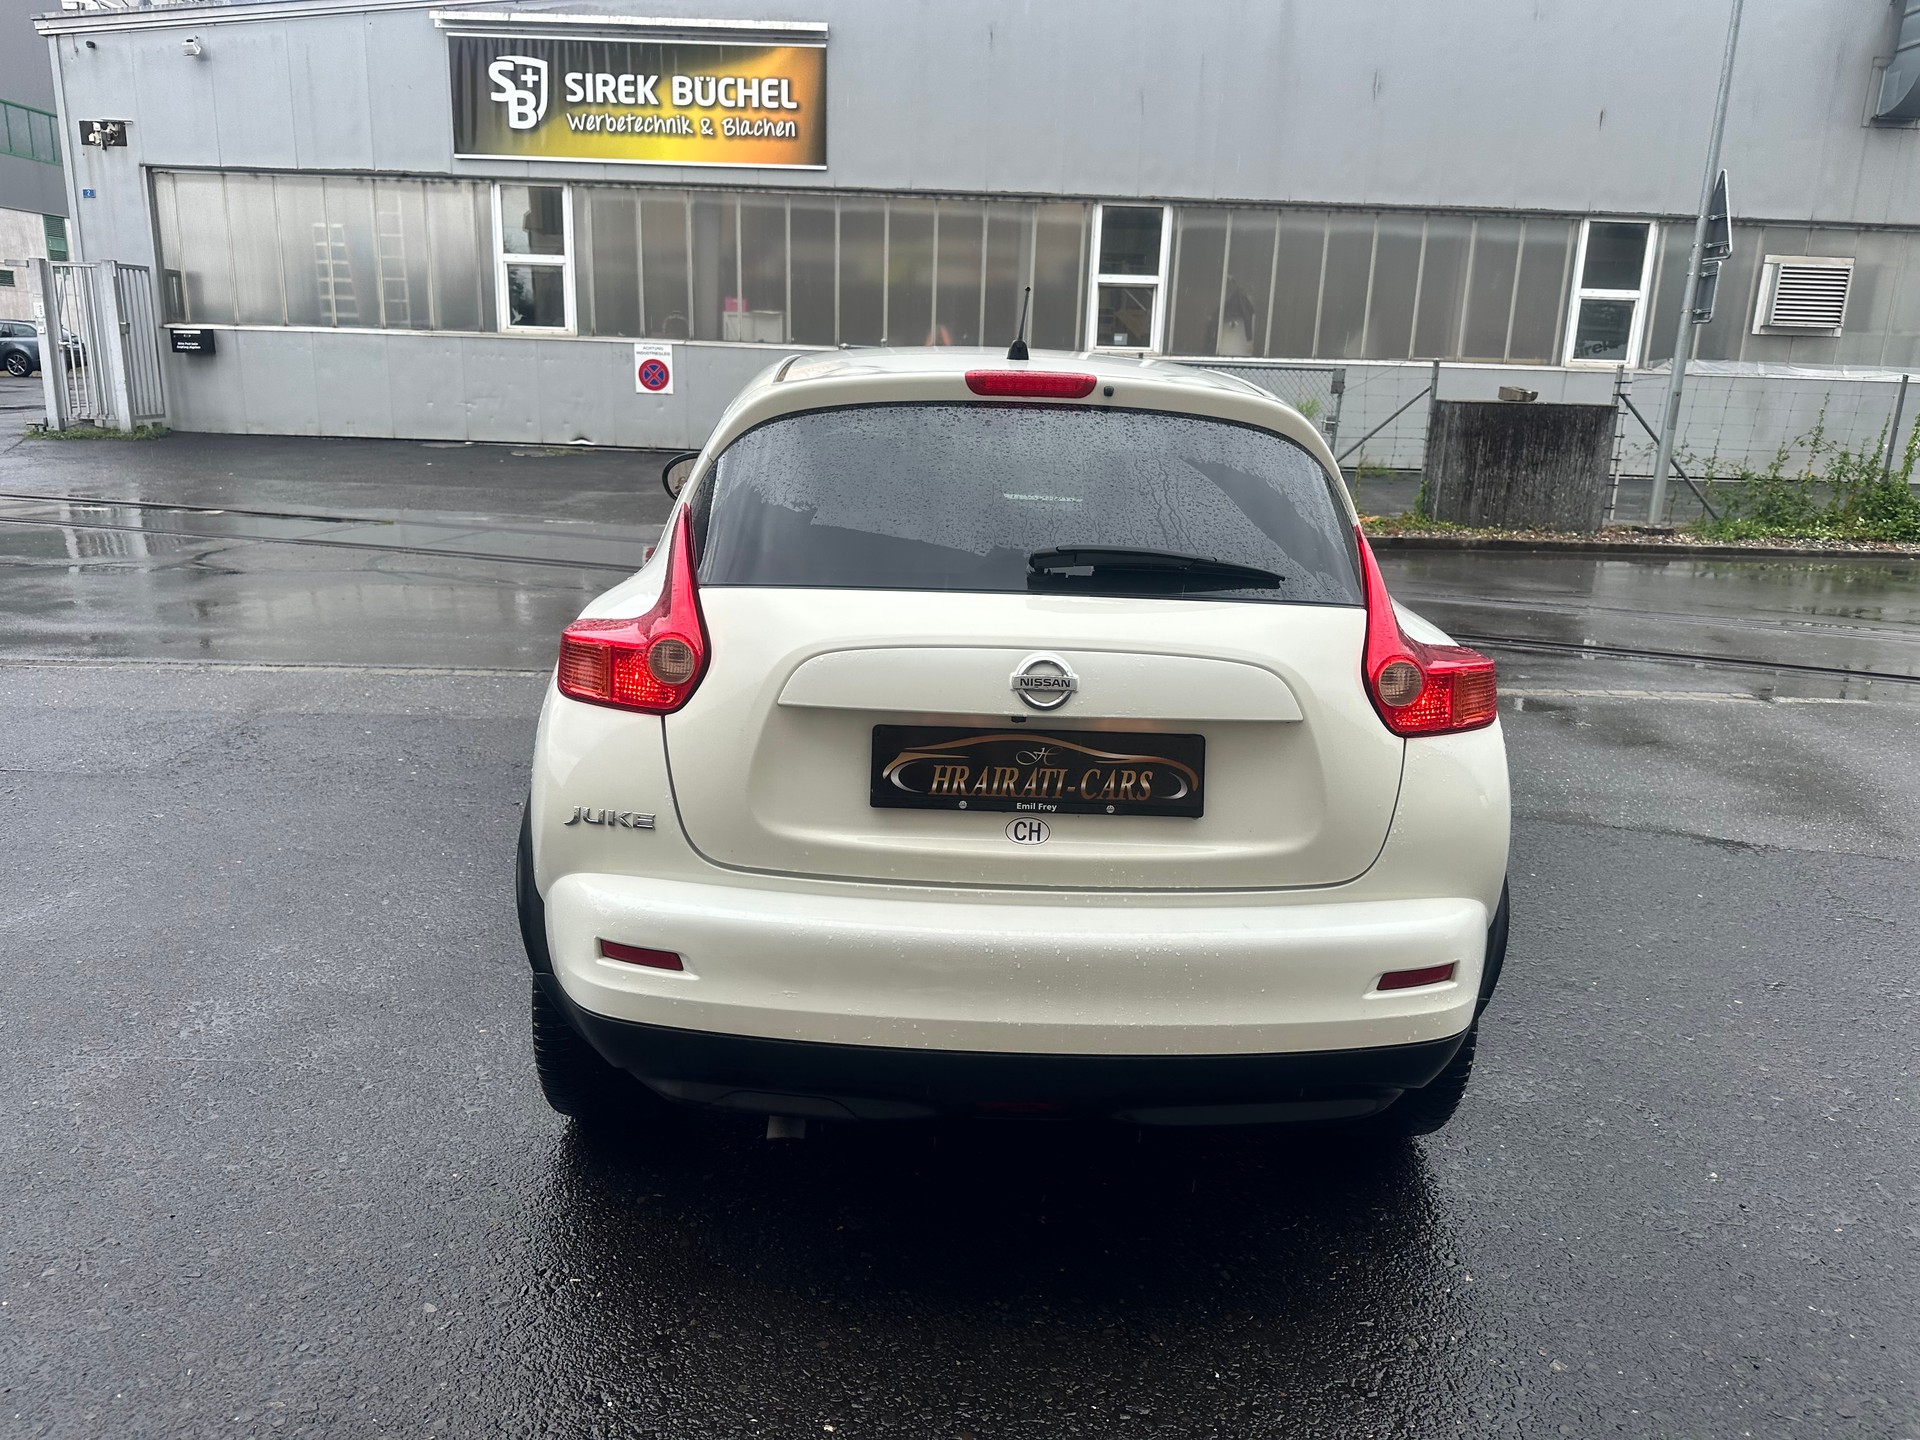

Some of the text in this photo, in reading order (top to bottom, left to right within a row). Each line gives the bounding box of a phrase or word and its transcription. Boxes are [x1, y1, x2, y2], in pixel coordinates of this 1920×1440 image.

[564, 72, 798, 109] SIREK BÜCHEL
[565, 112, 796, 137] Werbetechnik & Blachen
[1019, 678, 1071, 688] NISSAN
[563, 805, 656, 830] JUKE
[1016, 802, 1057, 812] Emil Frey
[1013, 821, 1042, 842] CH
